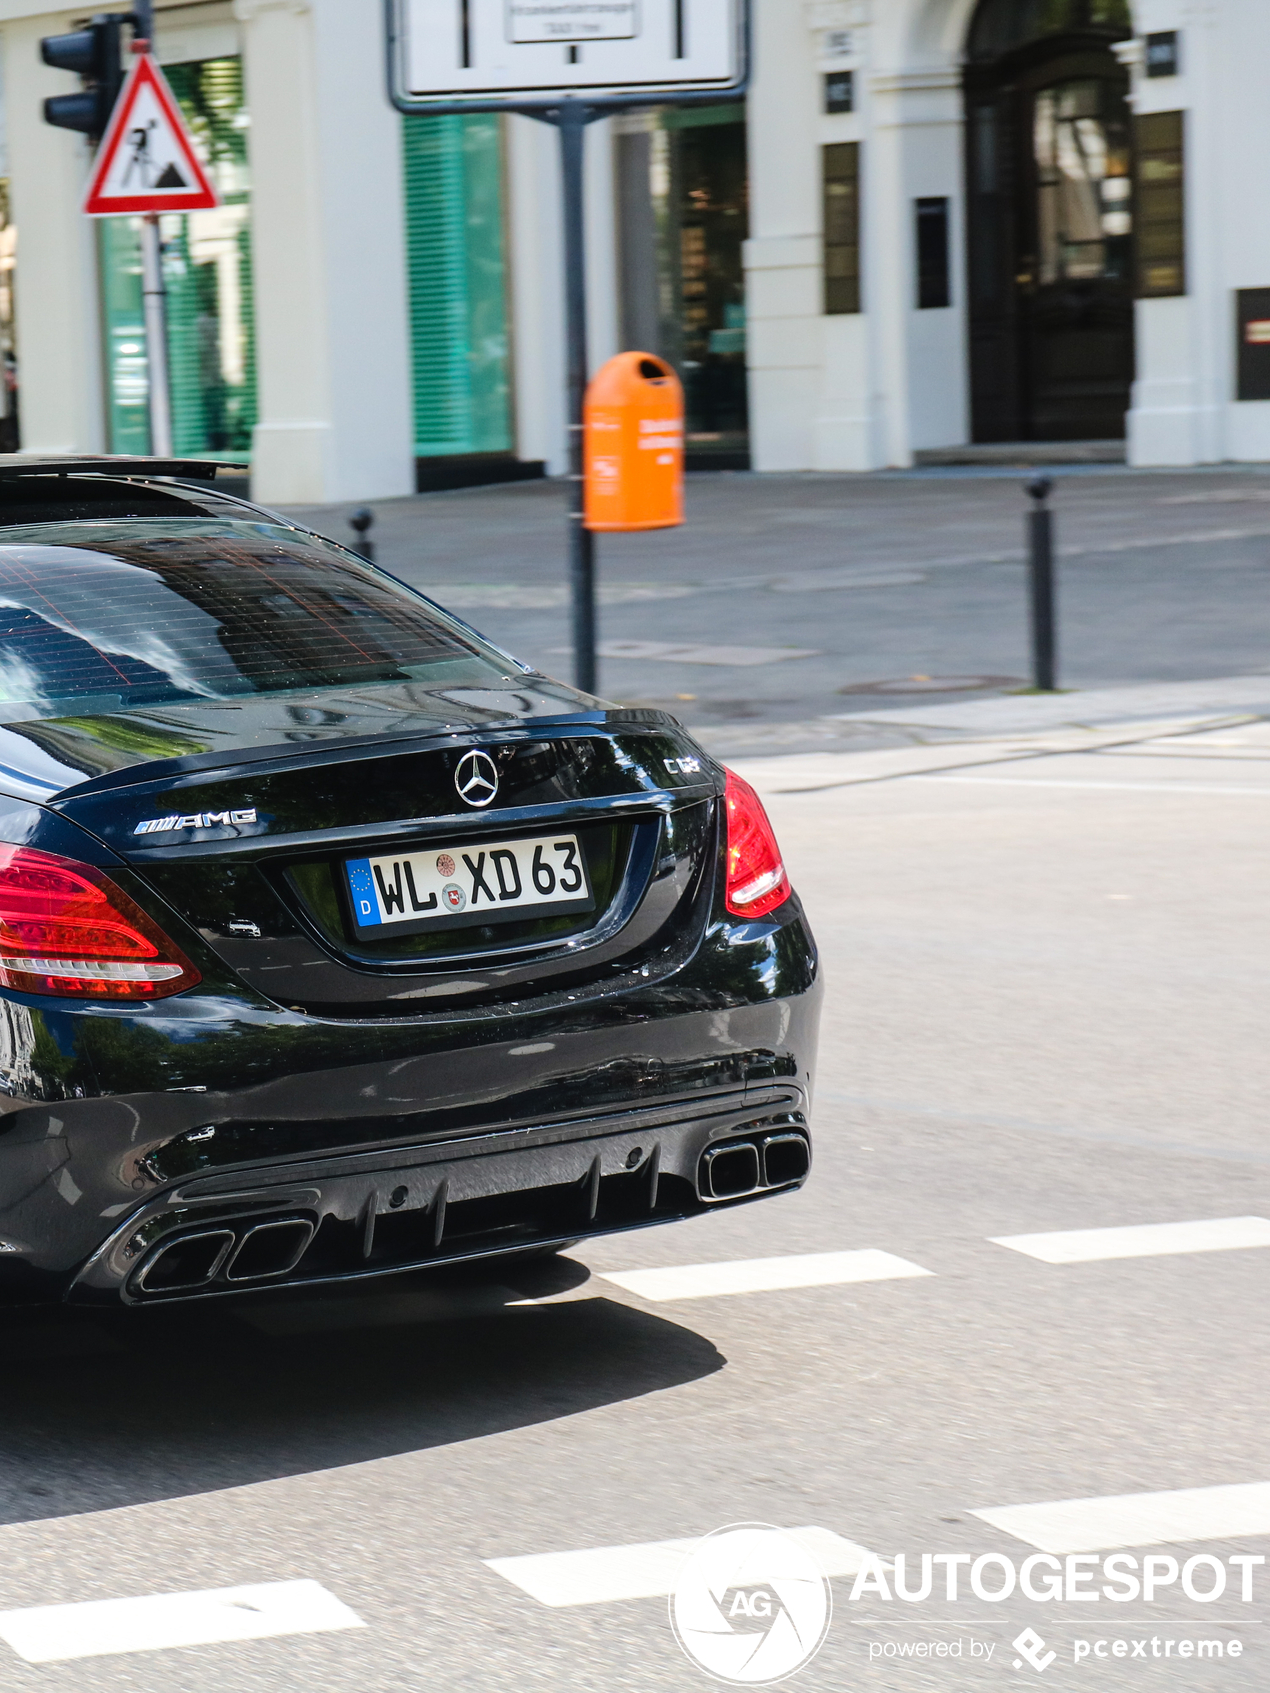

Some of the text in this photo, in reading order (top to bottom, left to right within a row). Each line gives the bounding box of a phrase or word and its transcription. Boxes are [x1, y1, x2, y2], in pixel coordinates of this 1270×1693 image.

[373, 860, 438, 916] WL
[461, 849, 523, 905] XD
[532, 841, 583, 896] 63
[361, 899, 372, 916] D
